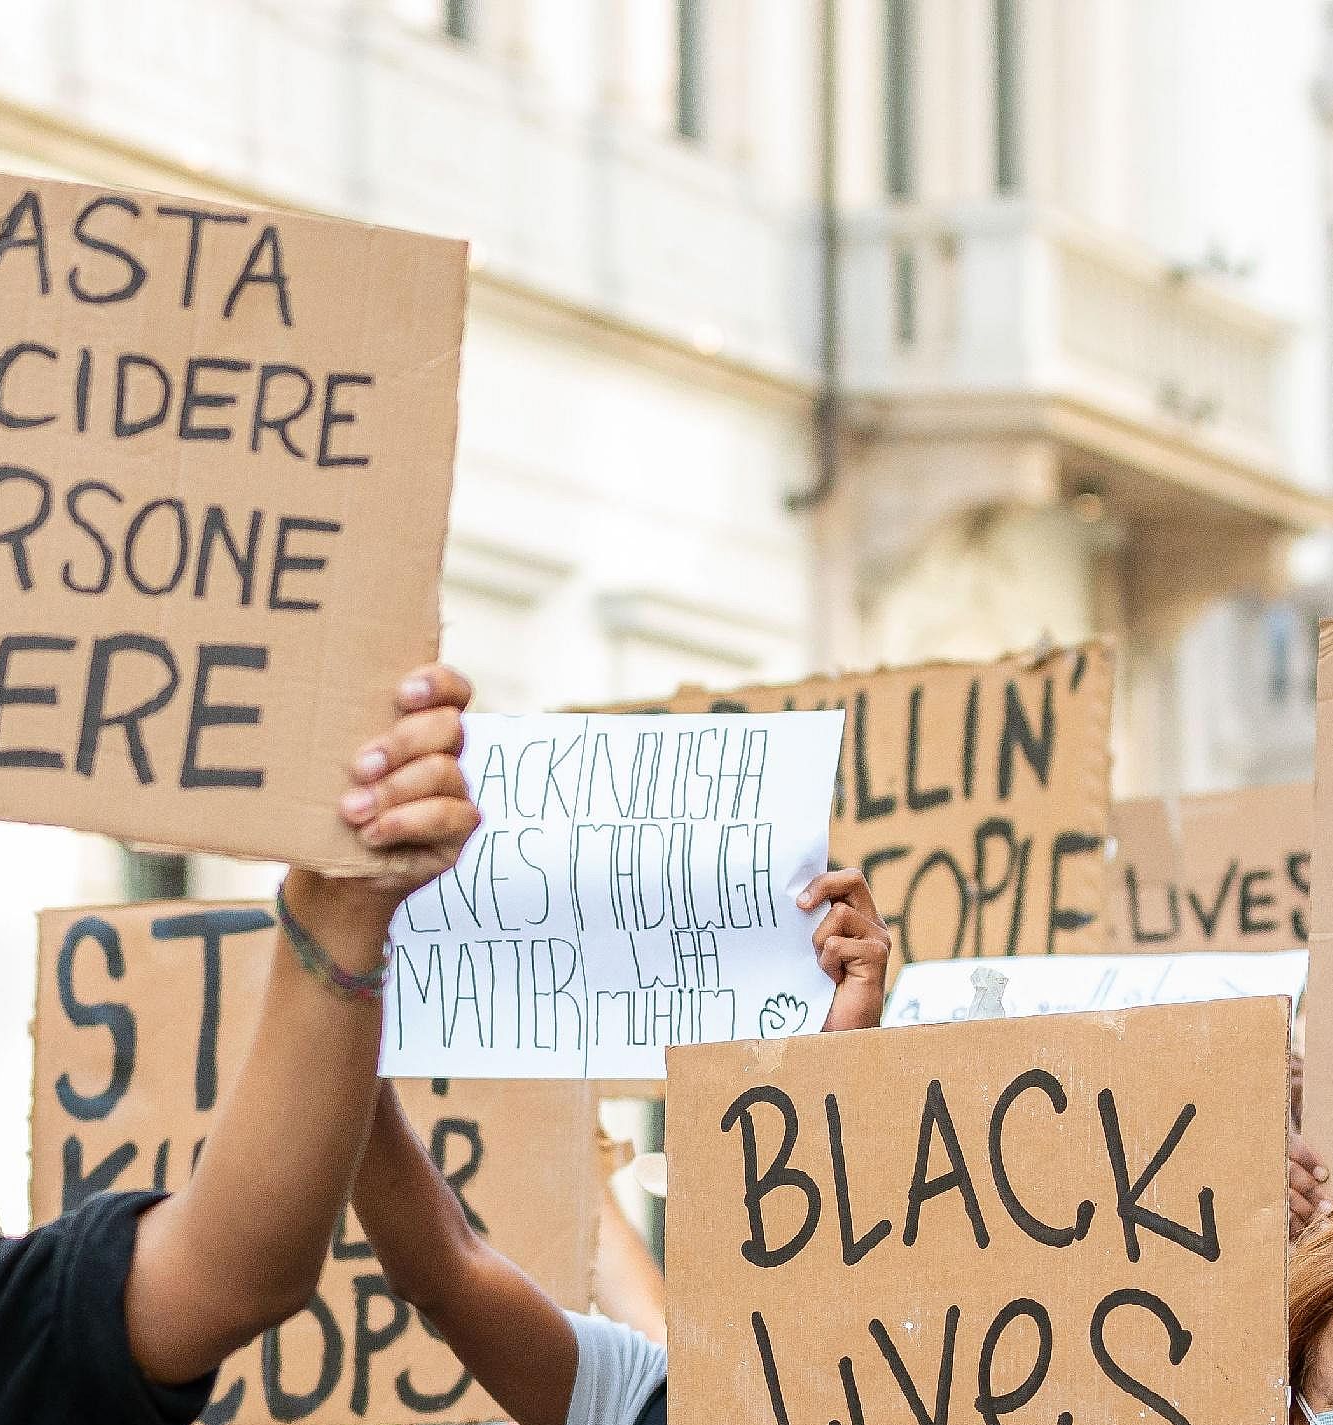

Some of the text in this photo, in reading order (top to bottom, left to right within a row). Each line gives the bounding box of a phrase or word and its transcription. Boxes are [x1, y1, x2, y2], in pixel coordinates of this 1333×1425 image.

[477, 735, 582, 819] ACK
[784, 653, 1086, 822] ILLIN'
[630, 931, 720, 989] WAA
[828, 820, 1103, 962] EOPLE
[55, 909, 274, 1121] ST
[396, 938, 581, 1051] MATTER
[721, 1068, 1222, 1269] BLACK
